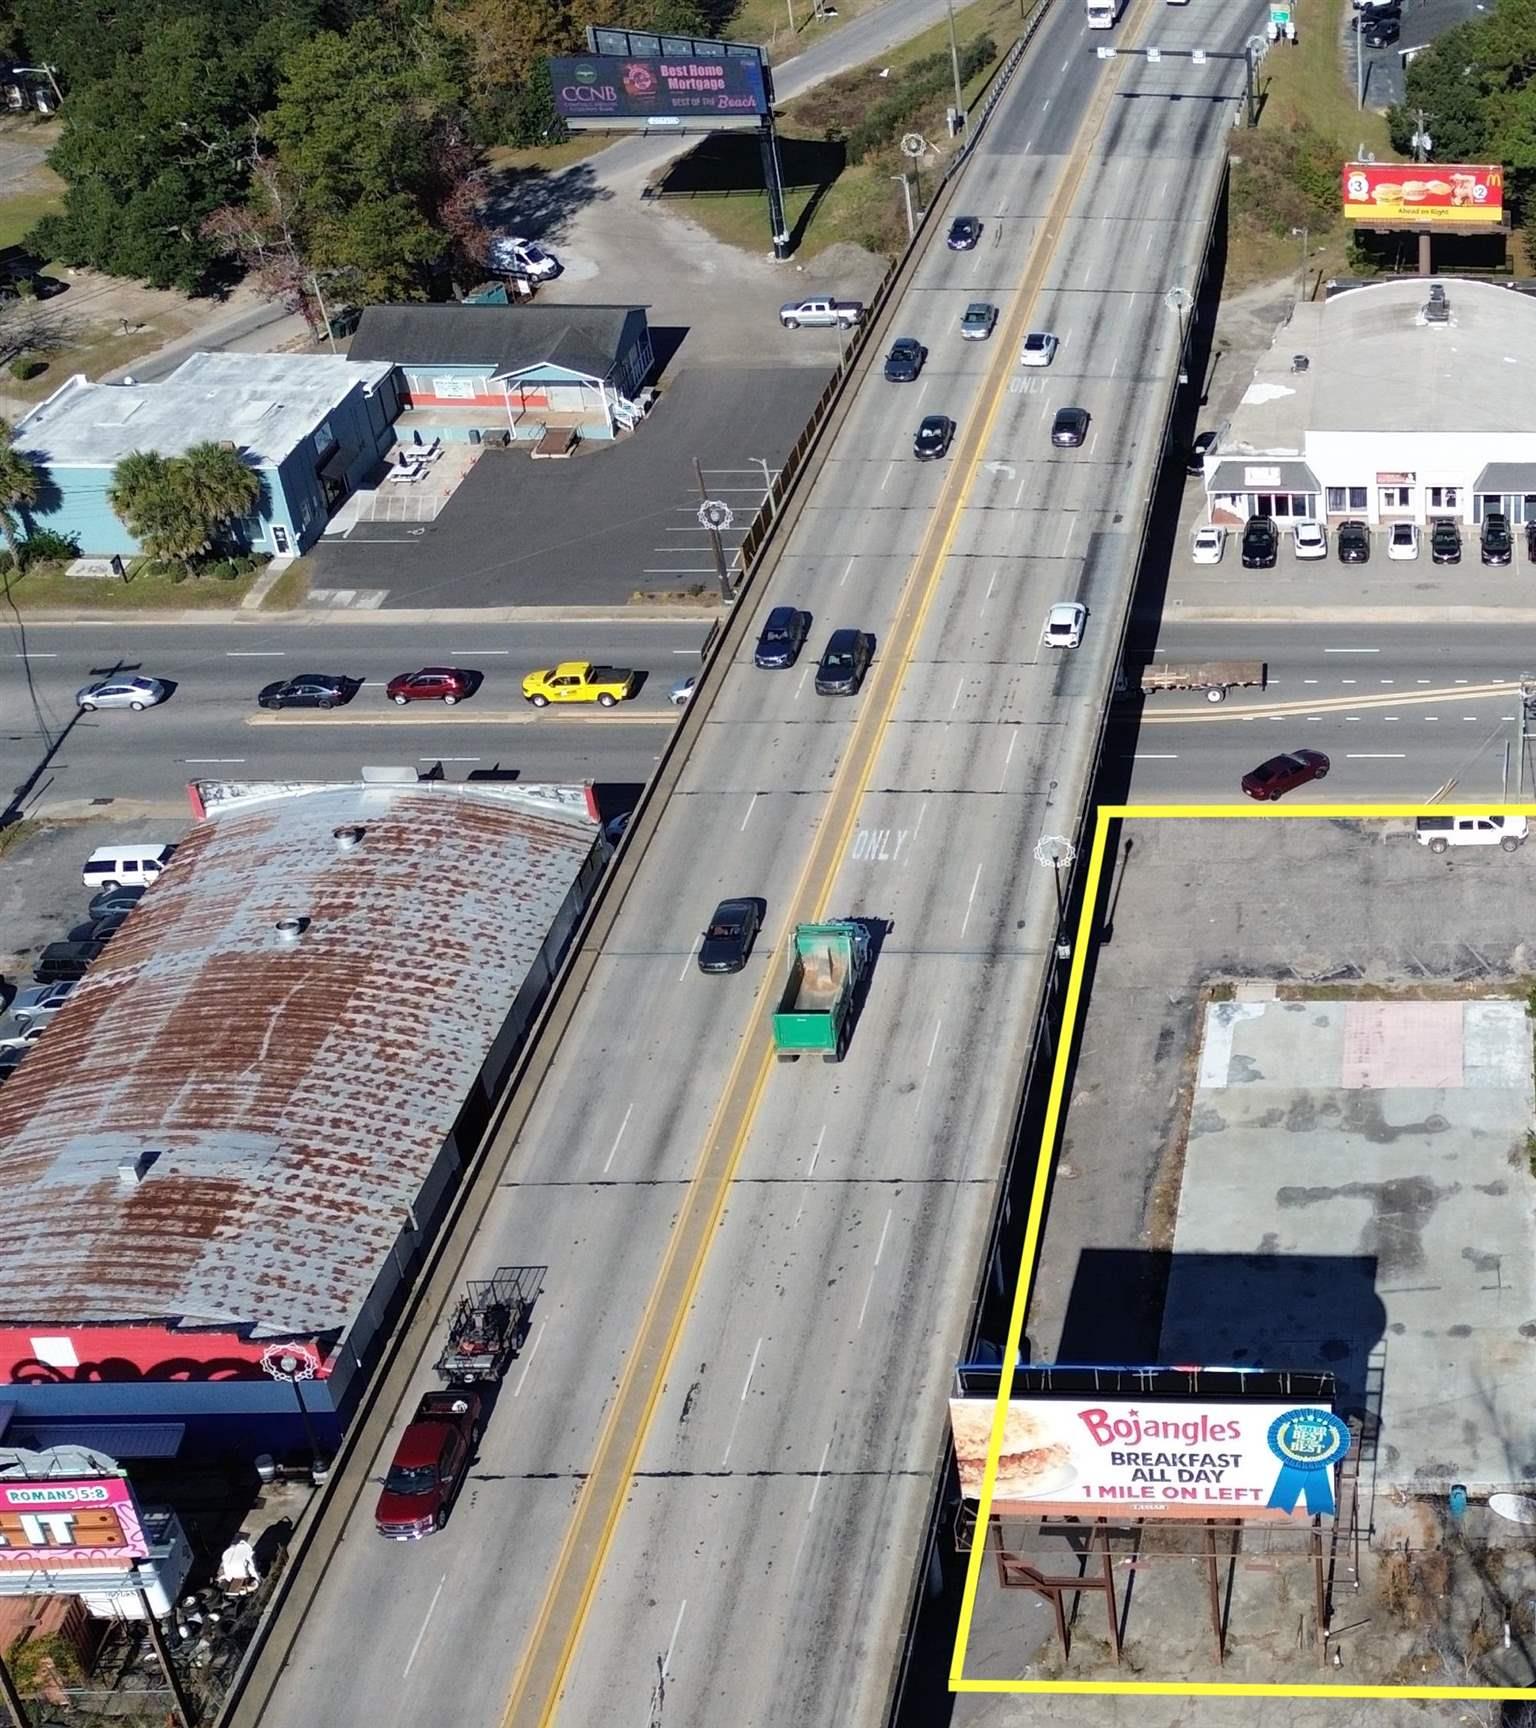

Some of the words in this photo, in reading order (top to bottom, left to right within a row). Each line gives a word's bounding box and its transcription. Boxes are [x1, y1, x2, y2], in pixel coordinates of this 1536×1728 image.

[660, 65, 688, 77] Best
[689, 65, 723, 77] Home
[668, 78, 726, 91] Mortgage
[562, 86, 617, 101] CCNB
[717, 95, 757, 109] Beach
[1008, 377, 1050, 394] ONLY
[852, 829, 909, 861] ONLY
[1077, 1408, 1242, 1447] Bojangles
[1111, 1452, 1243, 1468] BREAKFAST
[1131, 1468, 1171, 1482] ALL
[1177, 1469, 1226, 1483] DAY
[9, 1490, 76, 1502] ROMANS
[80, 1489, 105, 1499] 5:8
[1082, 1485, 1092, 1498] 1
[1098, 1486, 1155, 1499] MILE
[1162, 1487, 1198, 1500] ON
[1204, 1487, 1264, 1501] LEFT
[20, 1513, 78, 1546] IT
